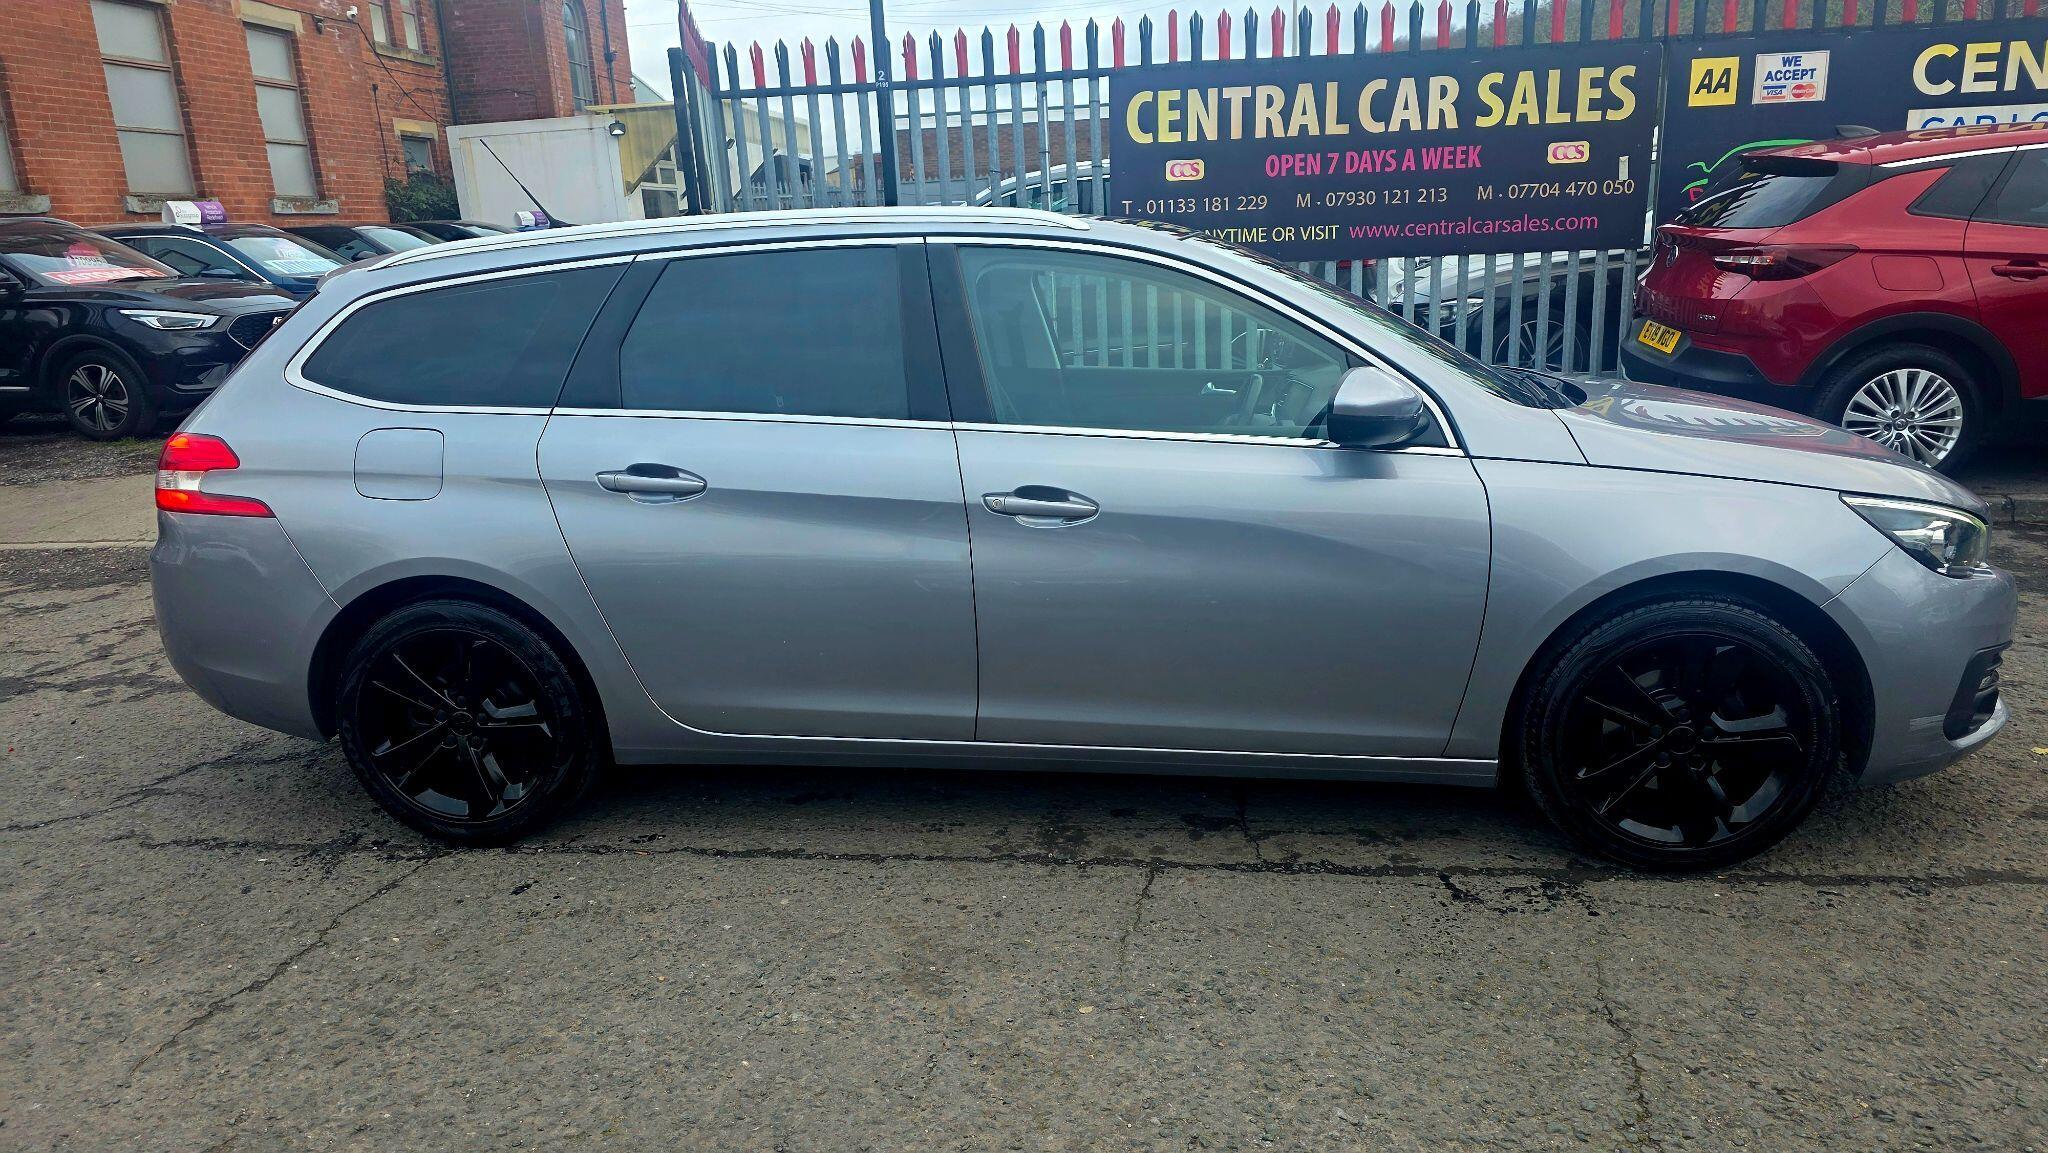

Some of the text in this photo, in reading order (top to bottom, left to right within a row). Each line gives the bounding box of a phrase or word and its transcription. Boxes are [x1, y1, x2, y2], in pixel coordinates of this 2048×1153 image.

[1781, 55, 1803, 68] WE
[877, 70, 886, 81] 2
[1694, 67, 1732, 95] AA
[1764, 68, 1817, 82] ACCEPT
[1126, 64, 1637, 145] CENTRAL CAR SALES
[1265, 145, 1483, 177] OPEN 7 DAYS A WEEK
[1326, 191, 1376, 207] 07930
[1383, 189, 1409, 204] 121
[1417, 187, 1448, 203] 213
[1508, 182, 1561, 199] 07704
[1566, 181, 1598, 196] 470
[1603, 179, 1635, 195] 050
[1146, 198, 1196, 214] 01133
[1203, 197, 1230, 212] 181
[1237, 195, 1268, 211] 229
[1272, 226, 1295, 242] OR
[1300, 224, 1340, 241] VISIT
[1350, 213, 1599, 239] www.centralcarsales.com
